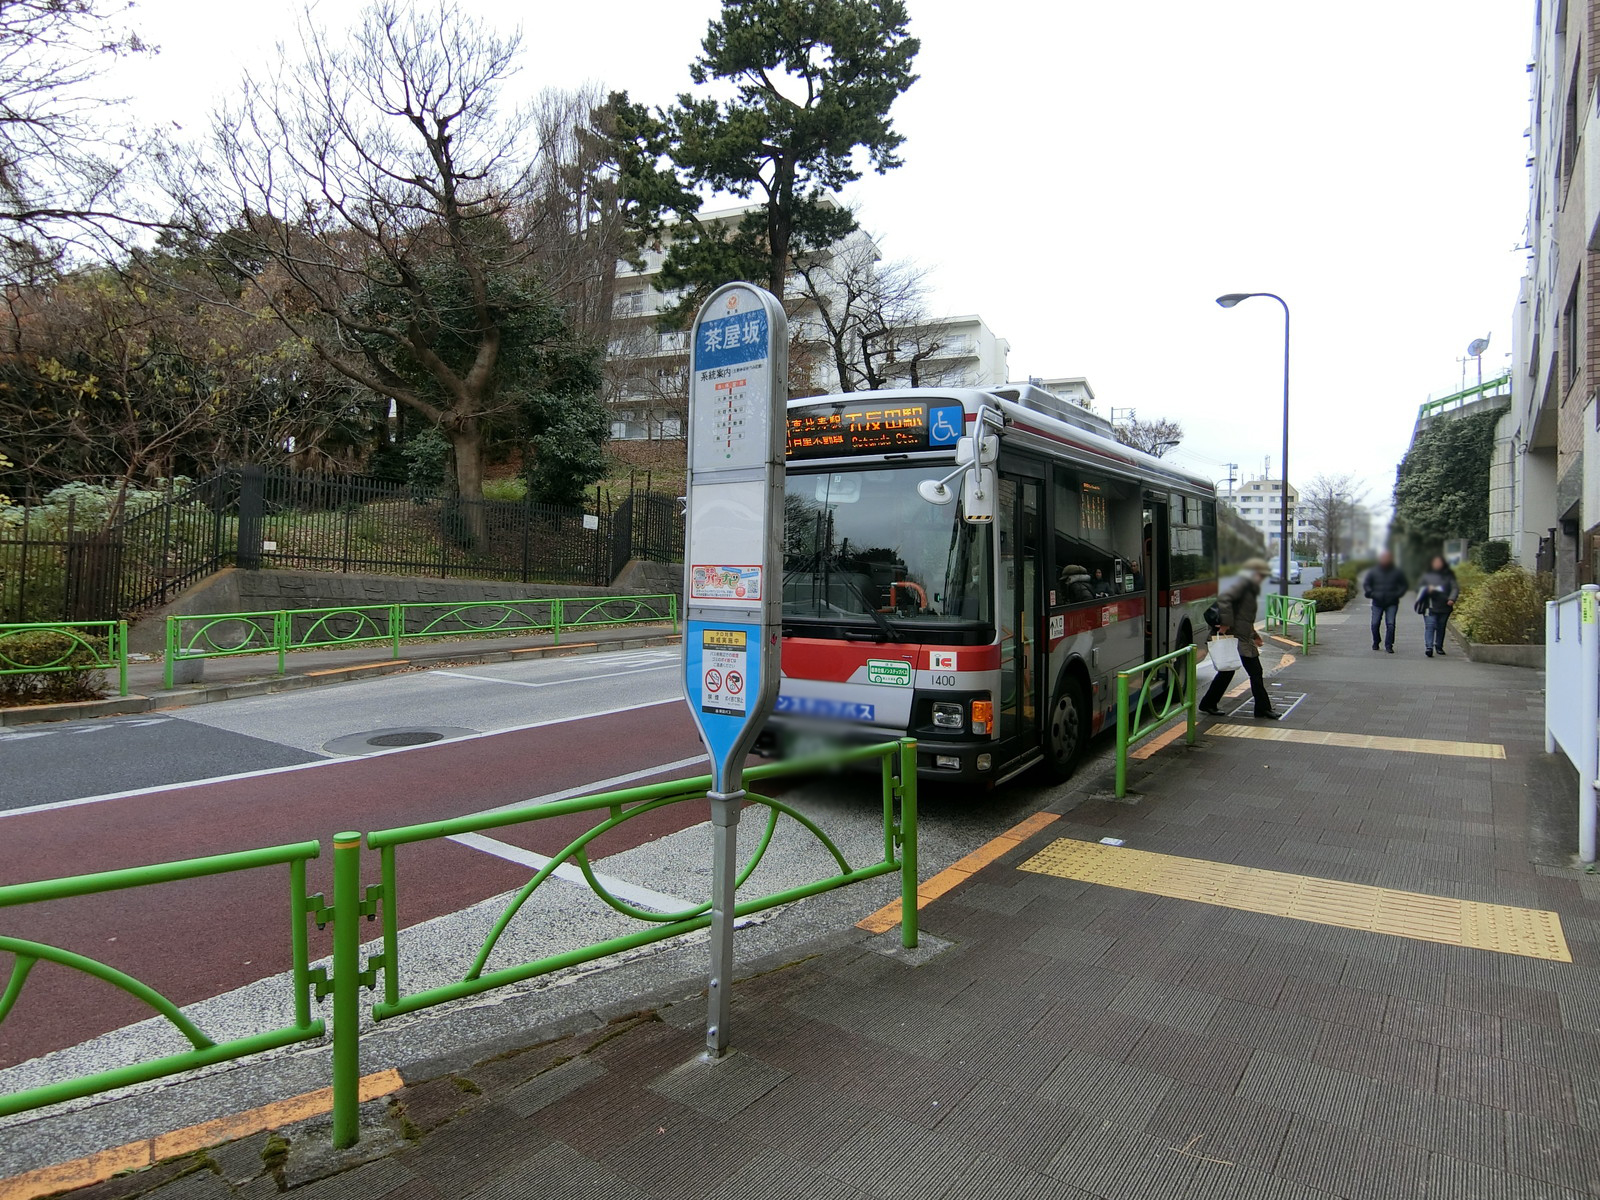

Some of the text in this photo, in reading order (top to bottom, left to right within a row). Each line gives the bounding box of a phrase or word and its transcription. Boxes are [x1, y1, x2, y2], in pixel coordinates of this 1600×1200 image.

[704, 319, 760, 352] 茶屋坂
[700, 367, 731, 381] 系統案内
[931, 674, 956, 687] 1400
